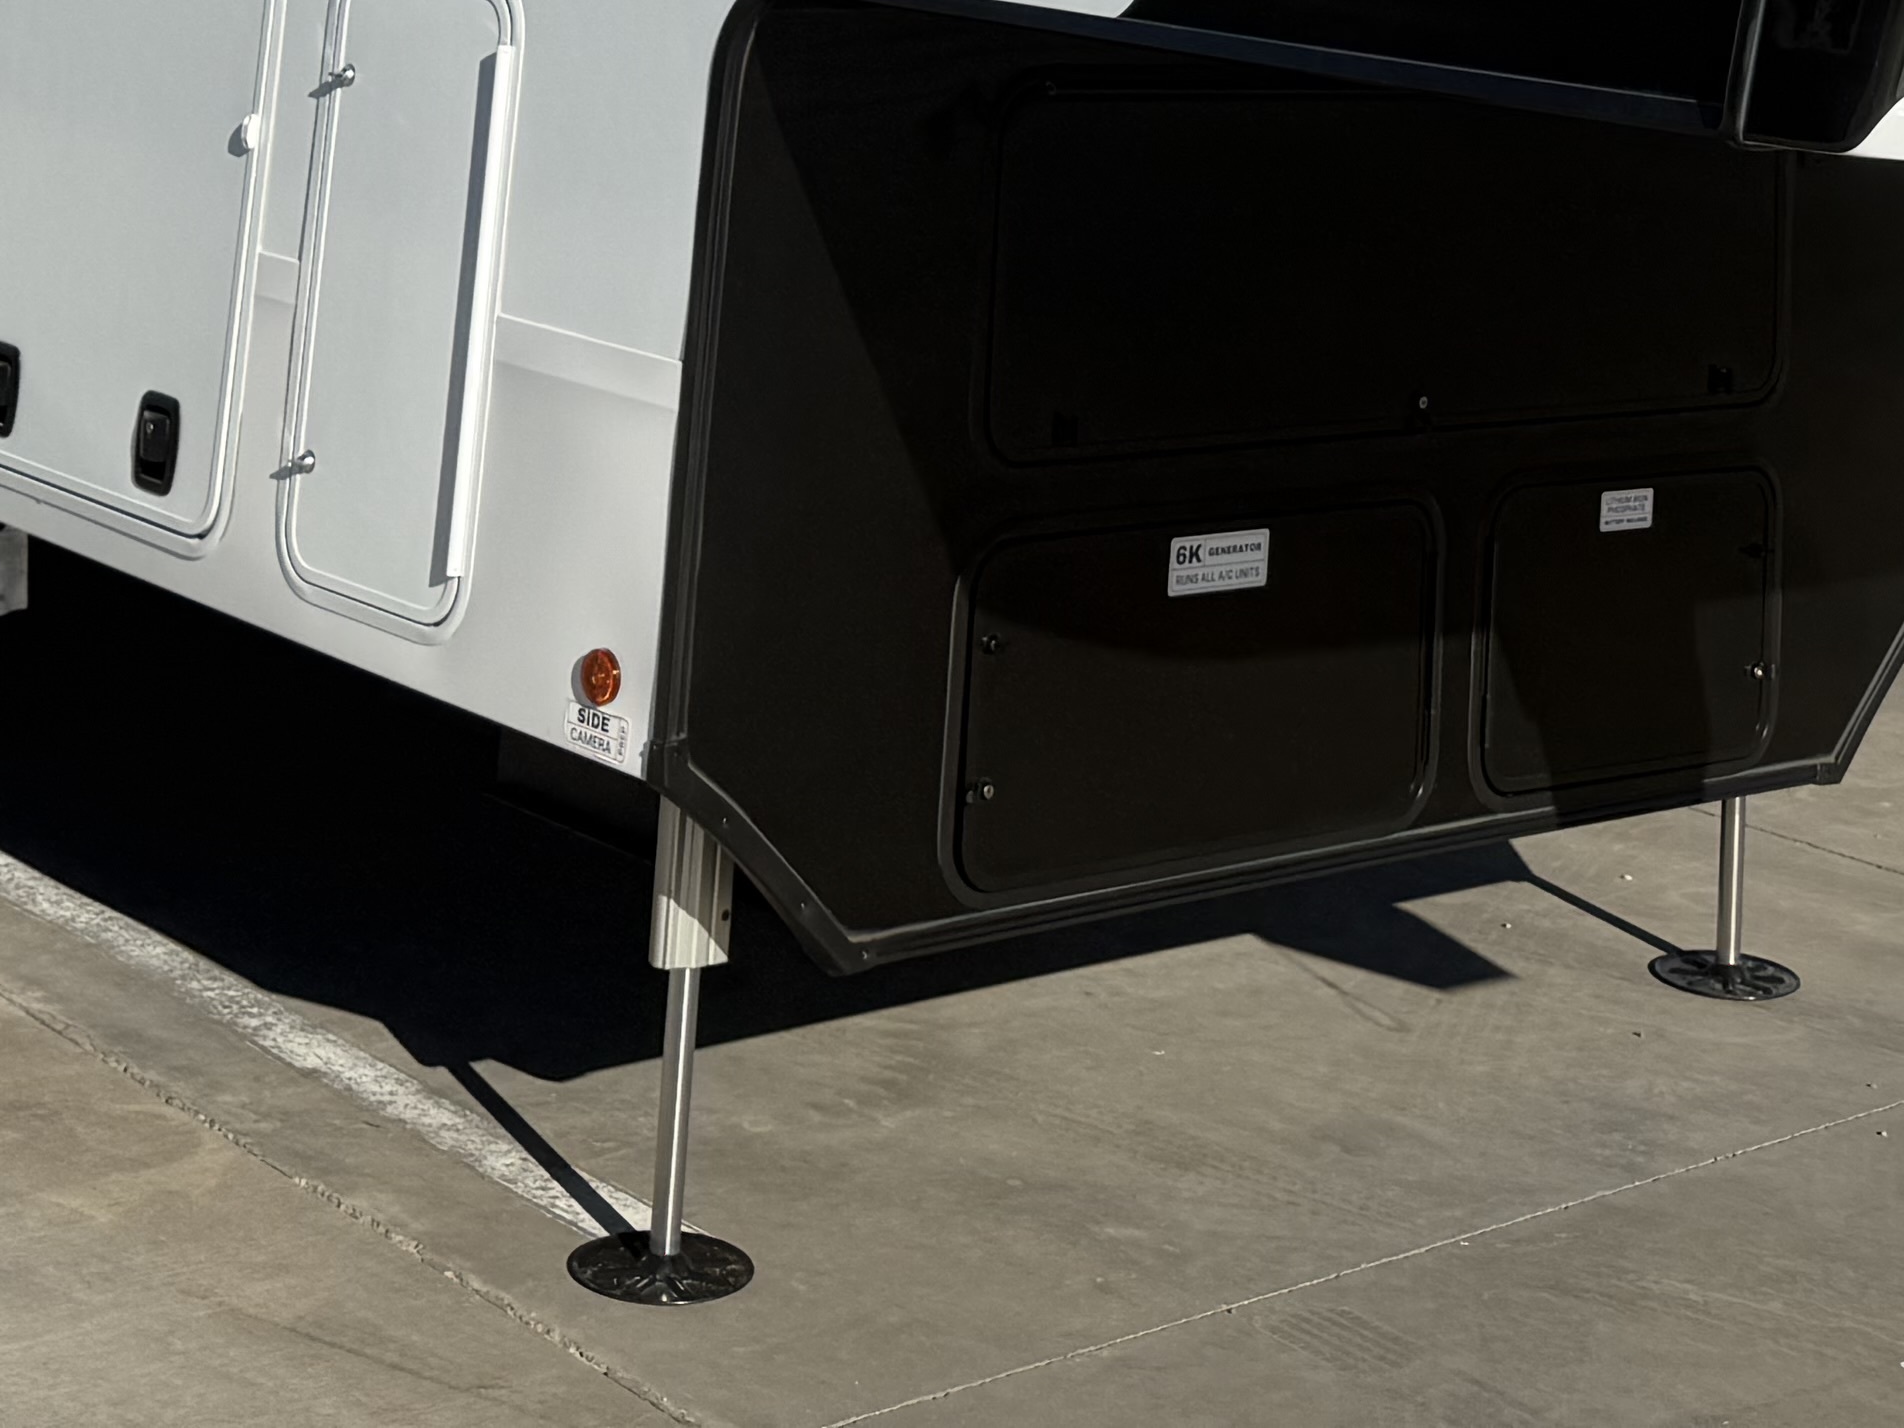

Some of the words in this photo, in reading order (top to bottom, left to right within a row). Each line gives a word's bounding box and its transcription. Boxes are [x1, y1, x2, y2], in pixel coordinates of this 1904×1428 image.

[1176, 543, 1202, 565] 6K
[1208, 542, 1262, 557] GENERATOR
[1176, 573, 1199, 586] RUNS
[1201, 571, 1216, 583] ALL
[1235, 566, 1260, 580] UNITS
[577, 707, 610, 733] SIDE
[570, 727, 611, 754] CAMERA
